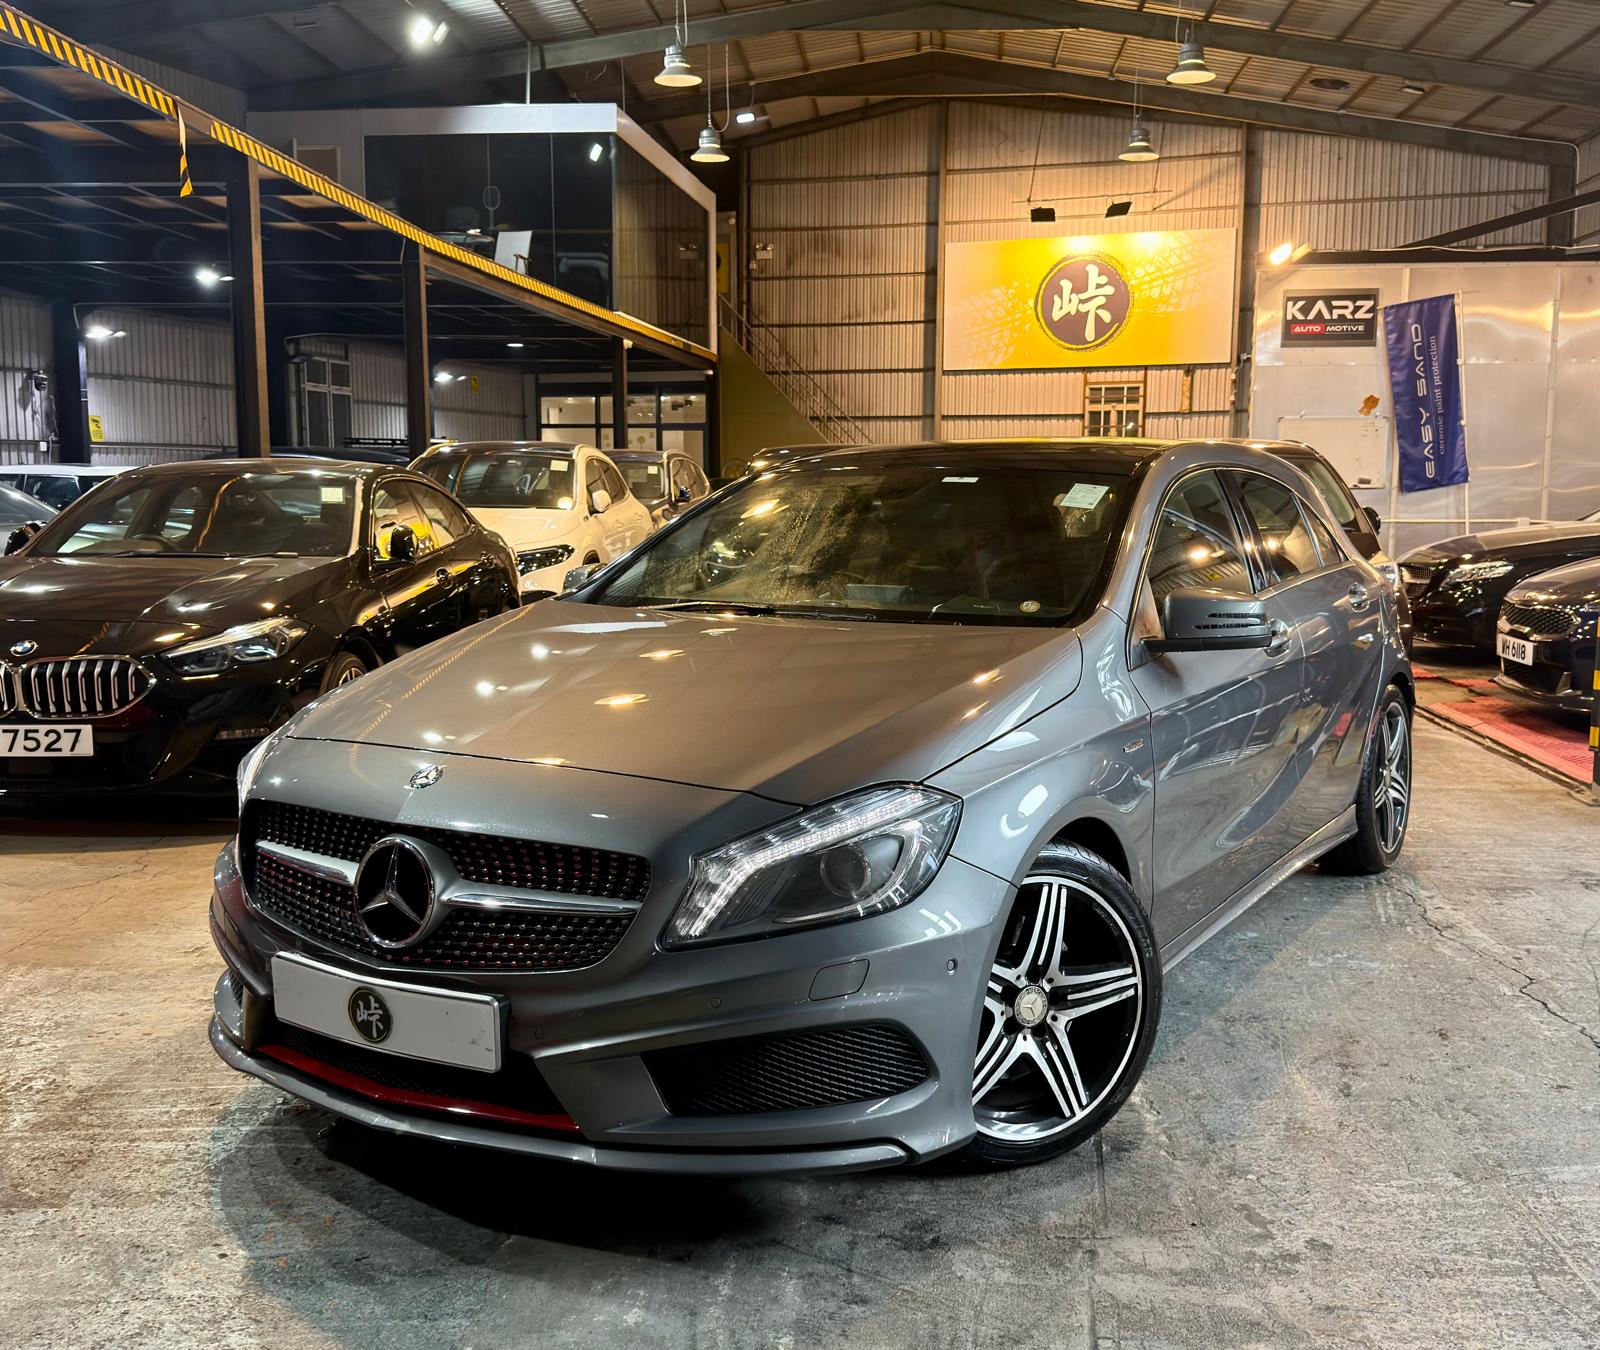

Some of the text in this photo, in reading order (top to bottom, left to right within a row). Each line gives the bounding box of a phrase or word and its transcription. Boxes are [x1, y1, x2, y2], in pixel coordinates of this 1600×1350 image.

[1286, 300, 1374, 320] KARZ
[1411, 323, 1435, 478] EASY SAND
[1429, 335, 1445, 455] ceramic paint protection
[1511, 641, 1526, 660] 6118
[2, 728, 82, 753] 7527
